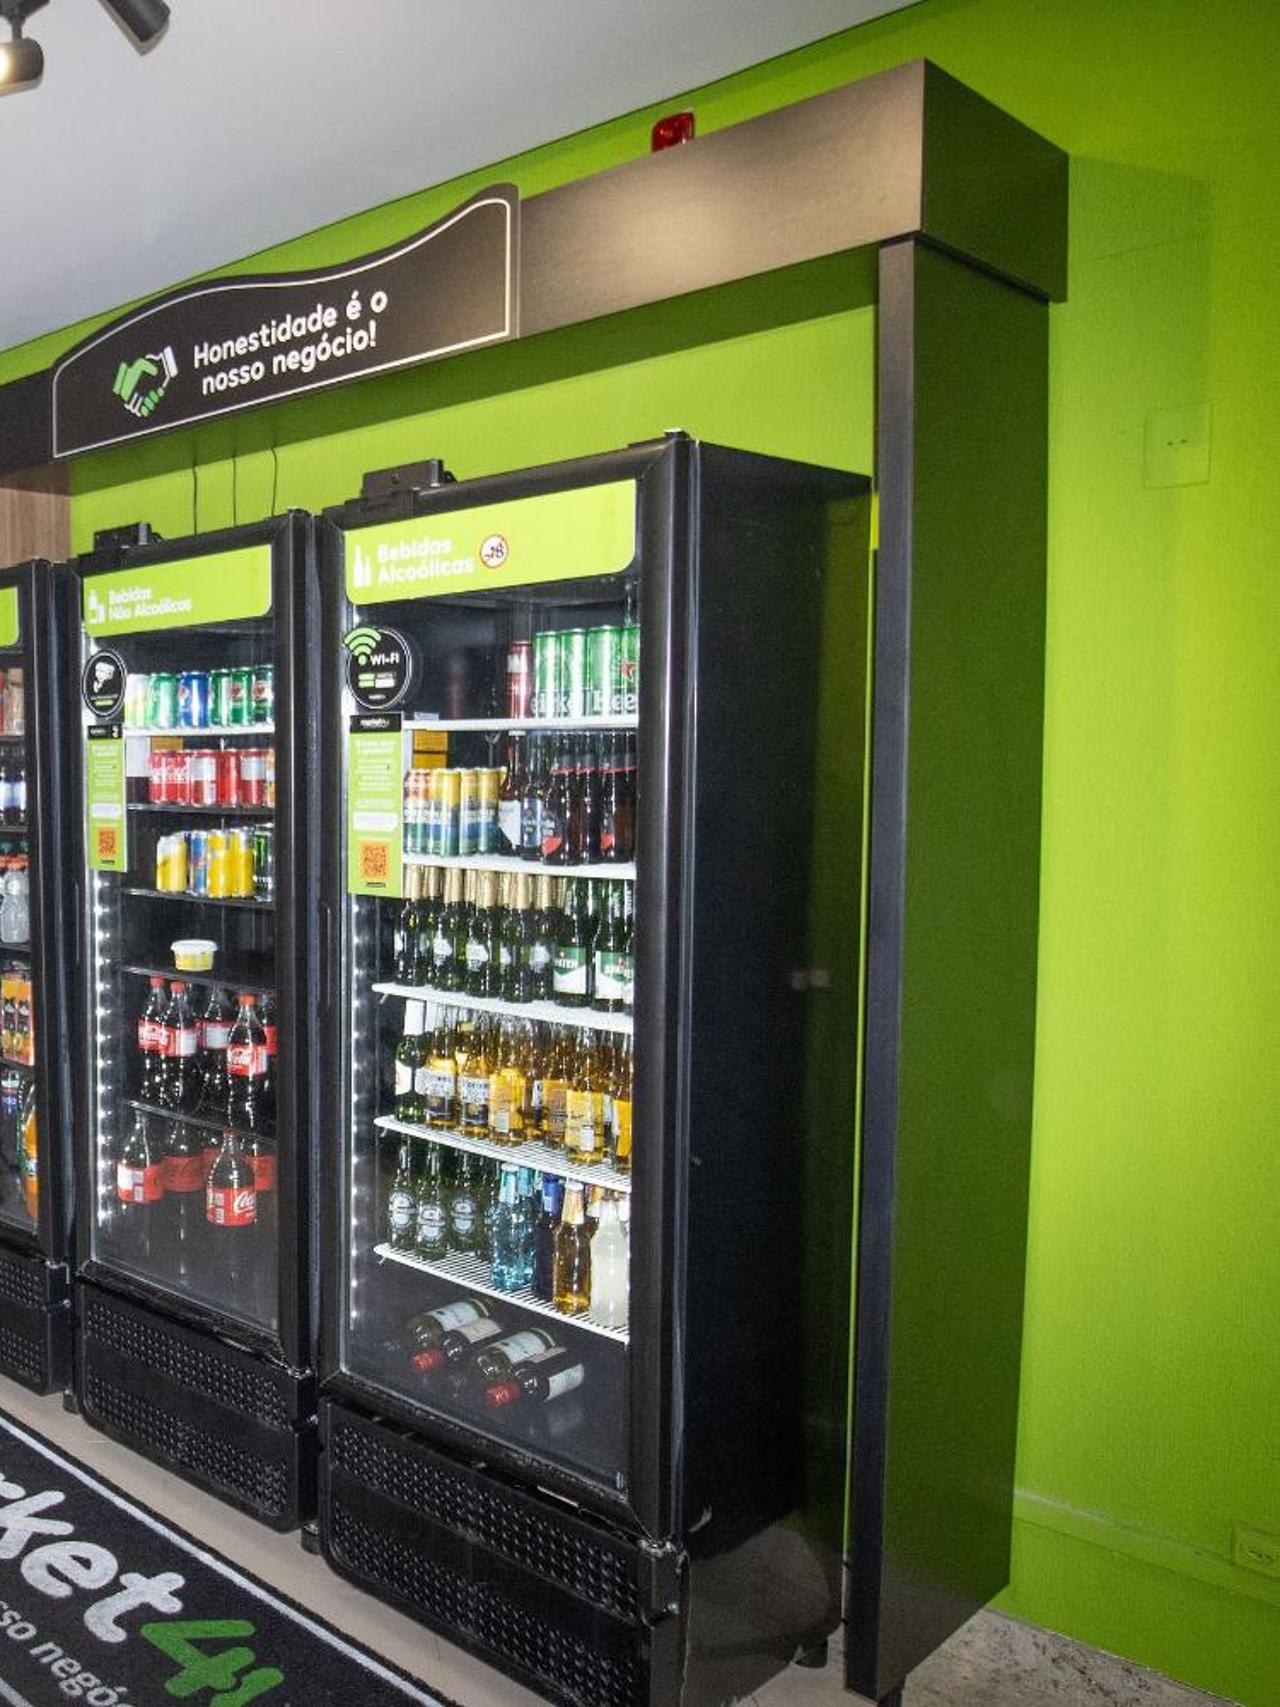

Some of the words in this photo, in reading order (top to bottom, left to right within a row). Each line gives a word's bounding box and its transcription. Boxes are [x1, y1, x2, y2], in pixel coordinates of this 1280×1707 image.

[194, 304, 338, 369] Honestidade
[346, 290, 362, 320] é
[370, 291, 388, 313] o
[202, 361, 266, 395] nosso
[272, 320, 377, 375] negócio!
[377, 537, 452, 565] Bebidas
[29, 1641, 136, 1707] negó
